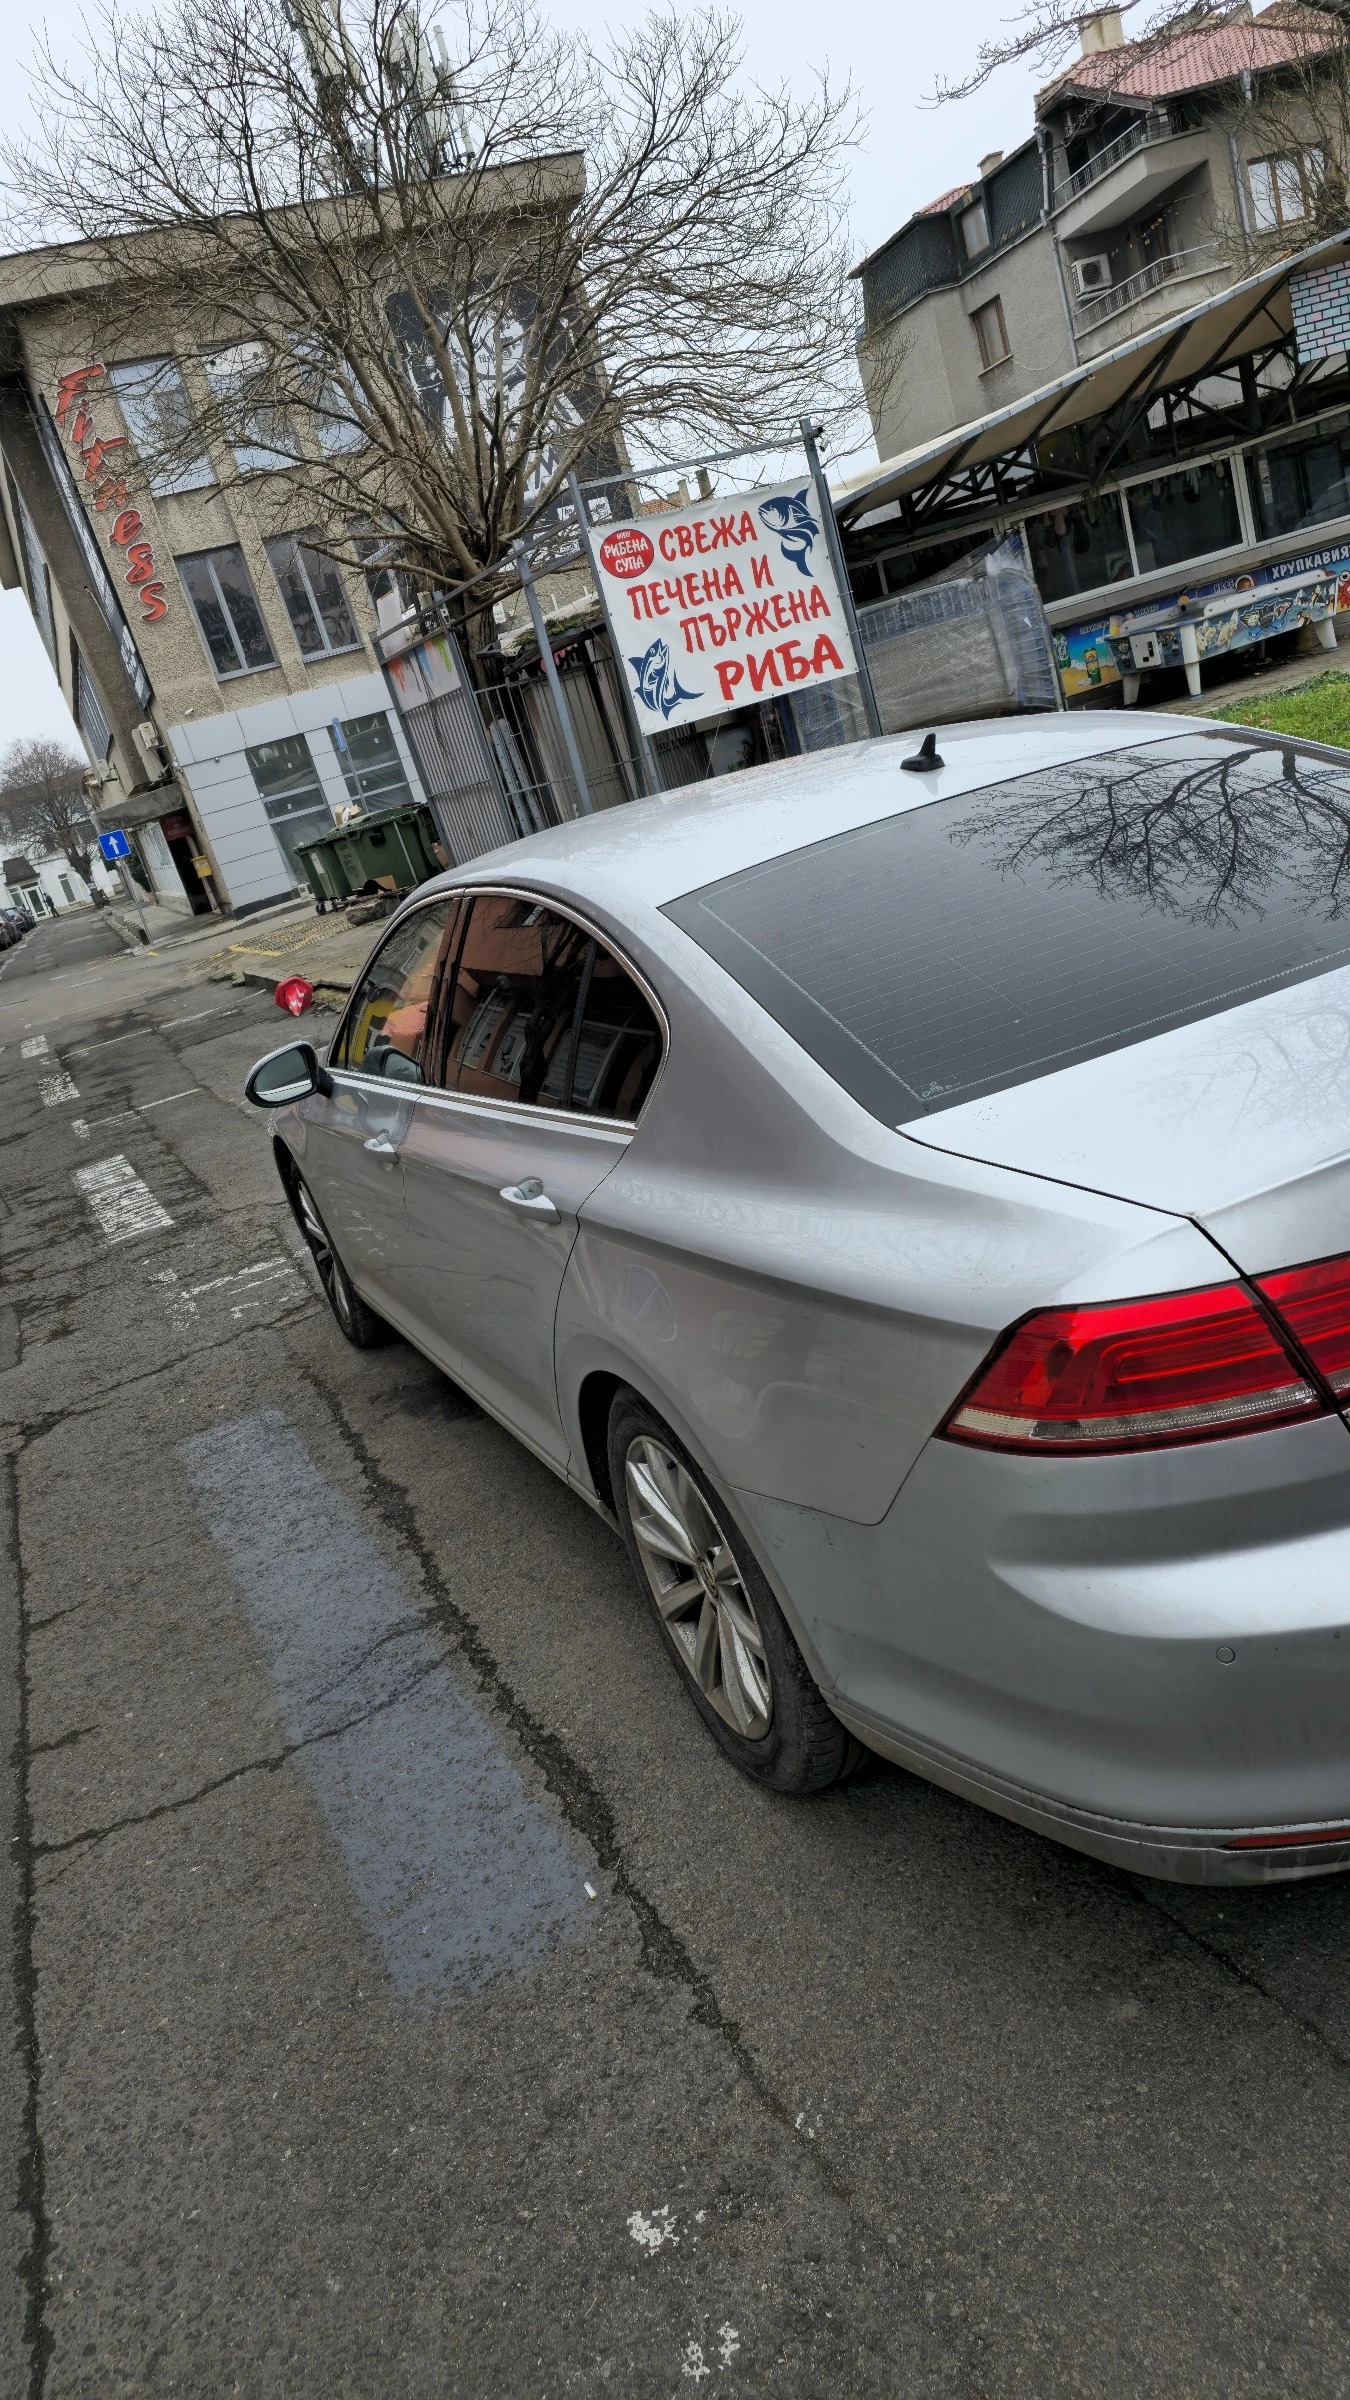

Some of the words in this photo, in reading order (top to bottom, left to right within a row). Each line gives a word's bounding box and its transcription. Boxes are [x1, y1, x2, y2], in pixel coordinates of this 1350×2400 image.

[56, 363, 168, 622] Fitness
[603, 536, 649, 559] РИБЕНА
[615, 554, 646, 573] СУПА
[659, 510, 759, 562] СВЕЖА
[1271, 543, 1350, 580] ХРУПКАВИЯ
[626, 563, 745, 621] ПЕЧЕНА
[751, 554, 775, 589] И
[680, 584, 832, 653] ПЪРЖЕНА
[714, 633, 845, 701] РИБА
